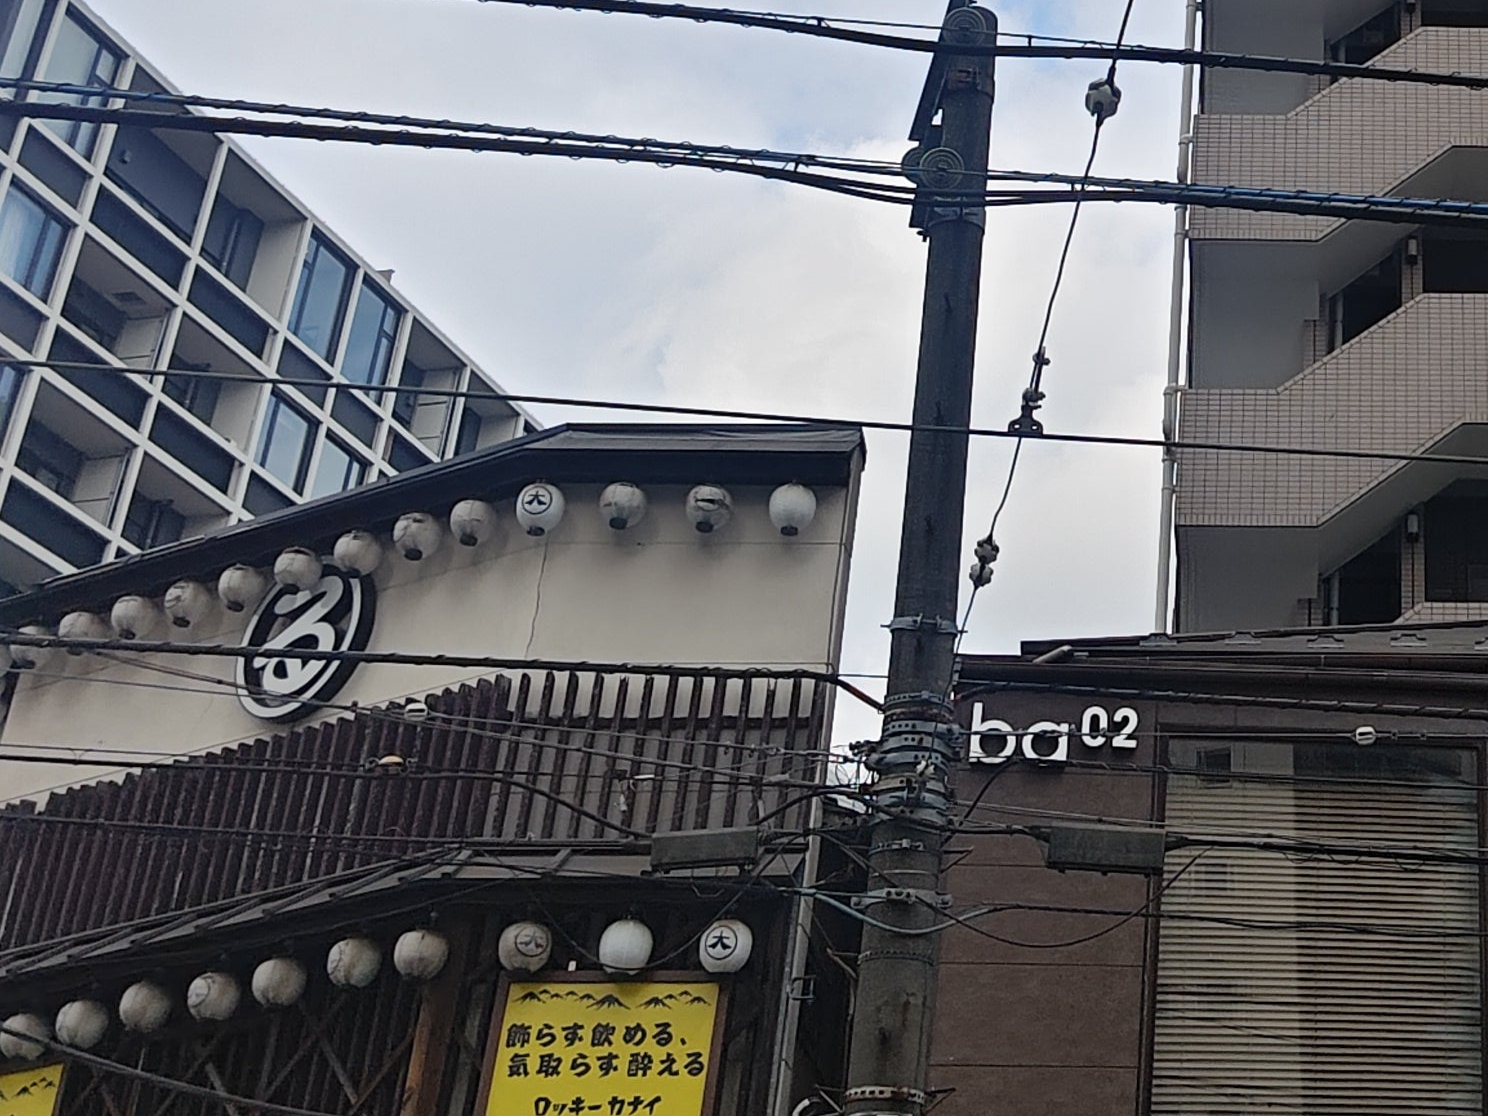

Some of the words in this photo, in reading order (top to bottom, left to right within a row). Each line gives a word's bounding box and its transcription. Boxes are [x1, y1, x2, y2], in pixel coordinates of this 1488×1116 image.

[968, 701, 1071, 765] ba
[1080, 705, 1139, 749] 02
[507, 1051, 705, 1077] 気取らず酔える
